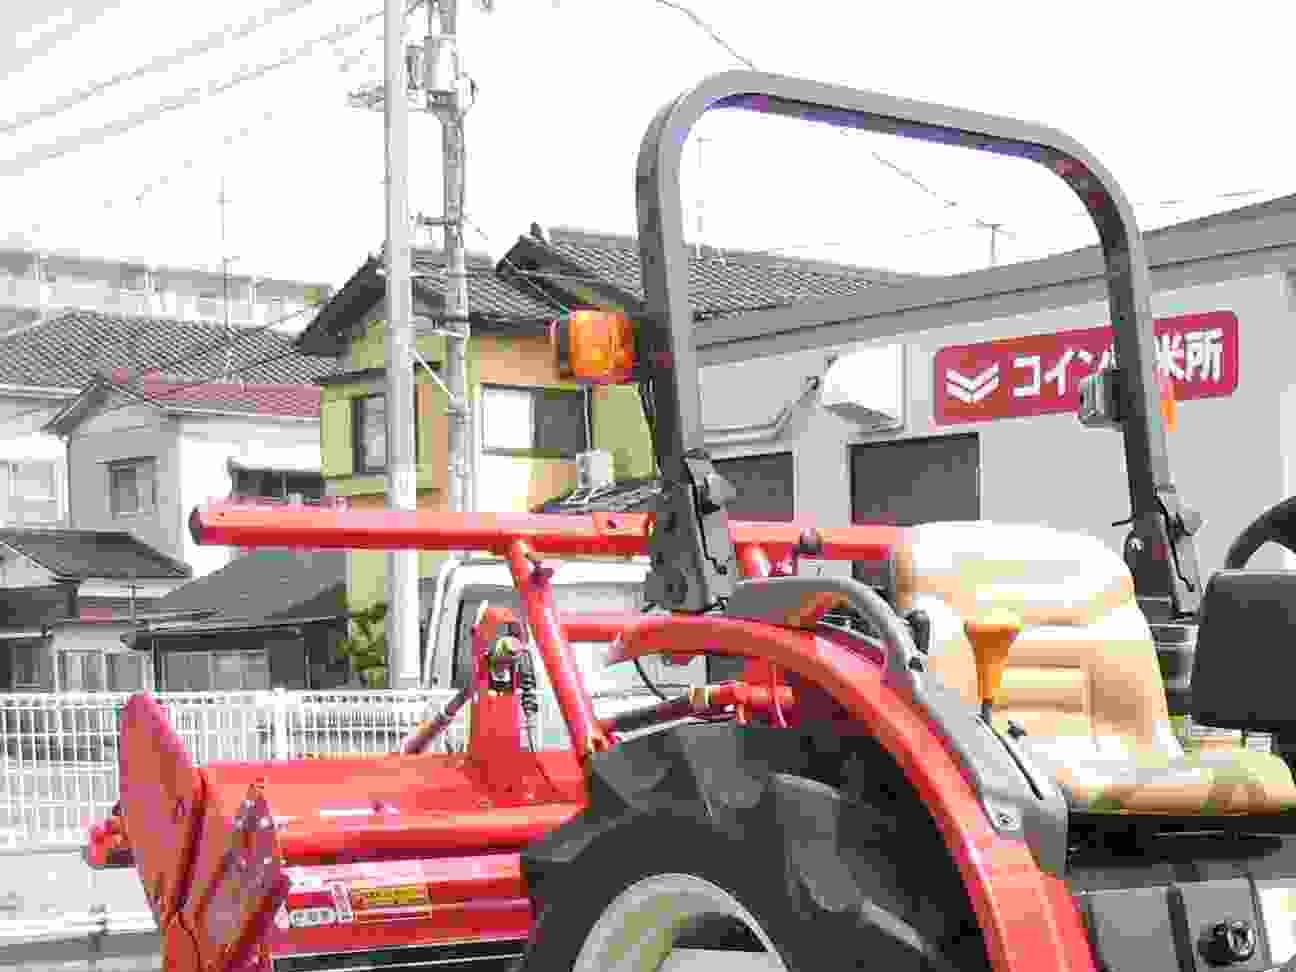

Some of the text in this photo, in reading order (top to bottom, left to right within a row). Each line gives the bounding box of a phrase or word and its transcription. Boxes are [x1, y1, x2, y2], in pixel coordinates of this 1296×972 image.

[1012, 327, 1224, 398] コイン米所
